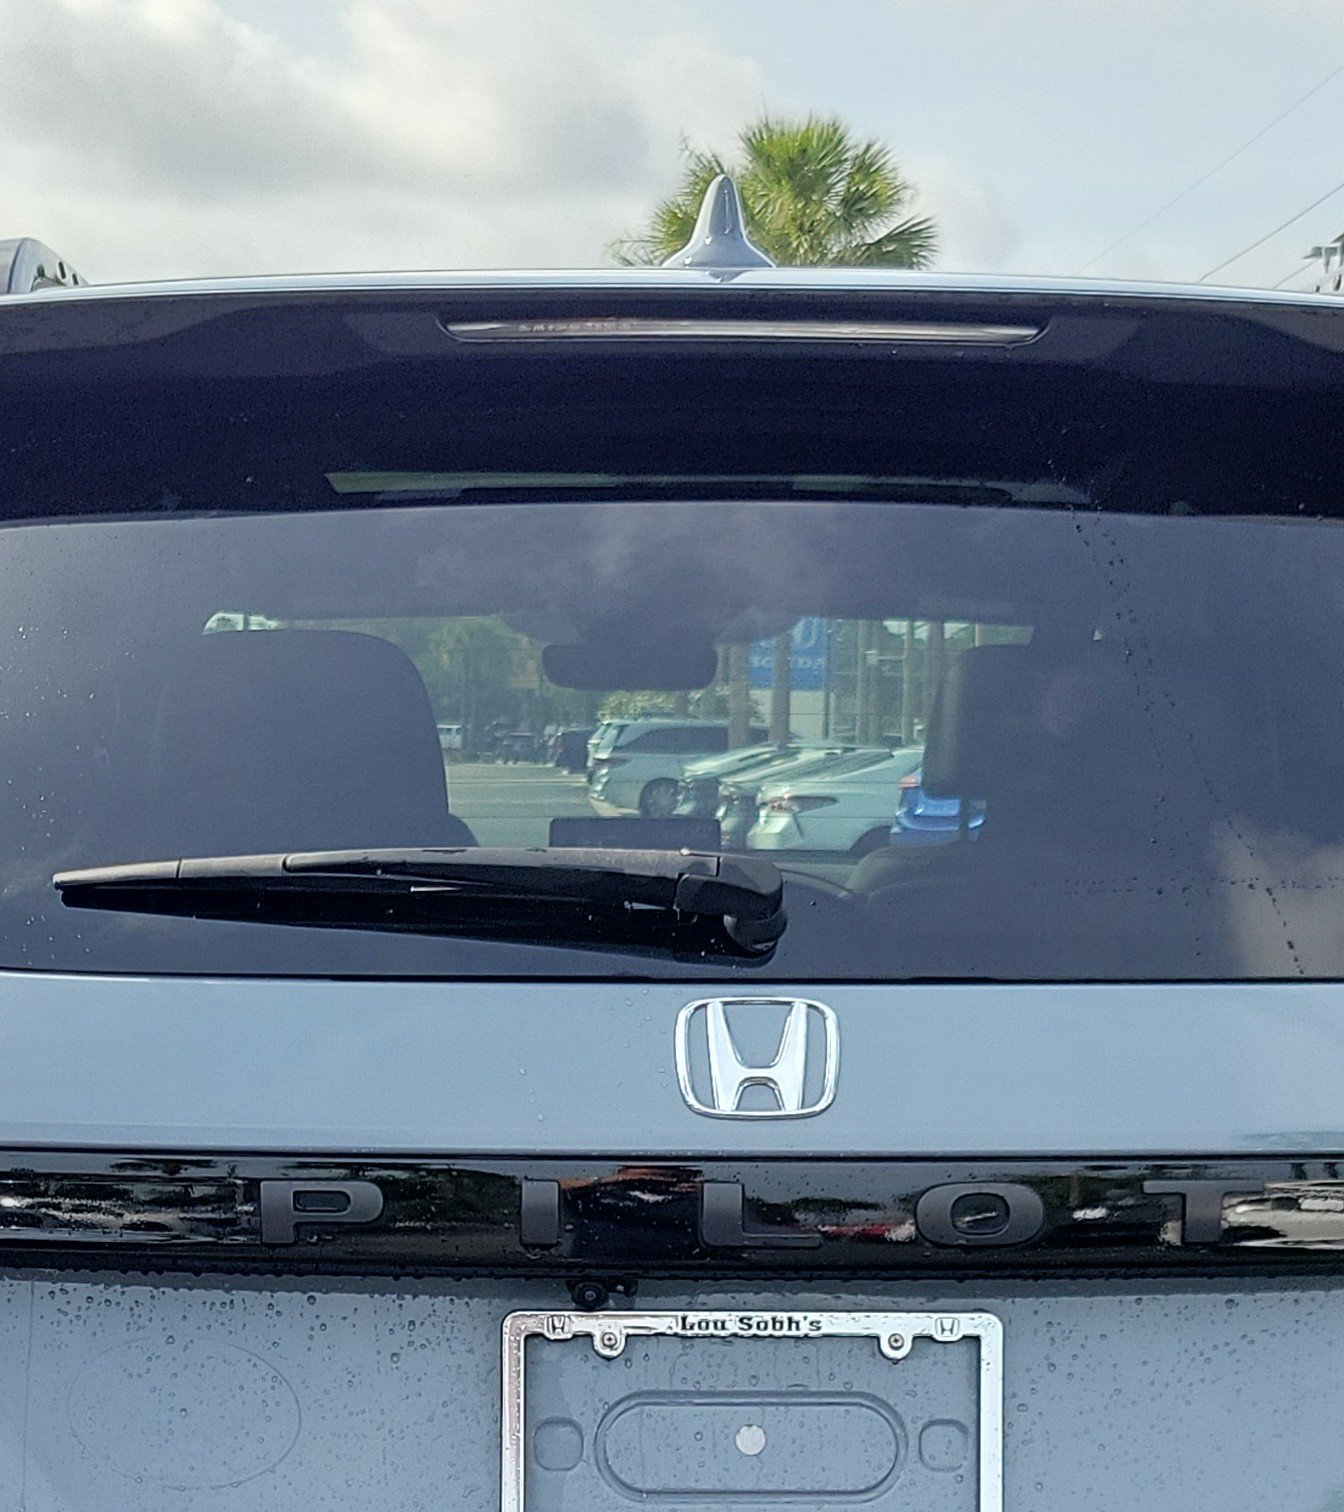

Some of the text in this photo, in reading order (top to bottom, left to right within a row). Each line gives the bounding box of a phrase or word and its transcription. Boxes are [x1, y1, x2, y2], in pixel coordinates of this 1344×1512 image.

[259, 1179, 1262, 1248] PILOT
[680, 1315, 823, 1332] Lou Sobh's
